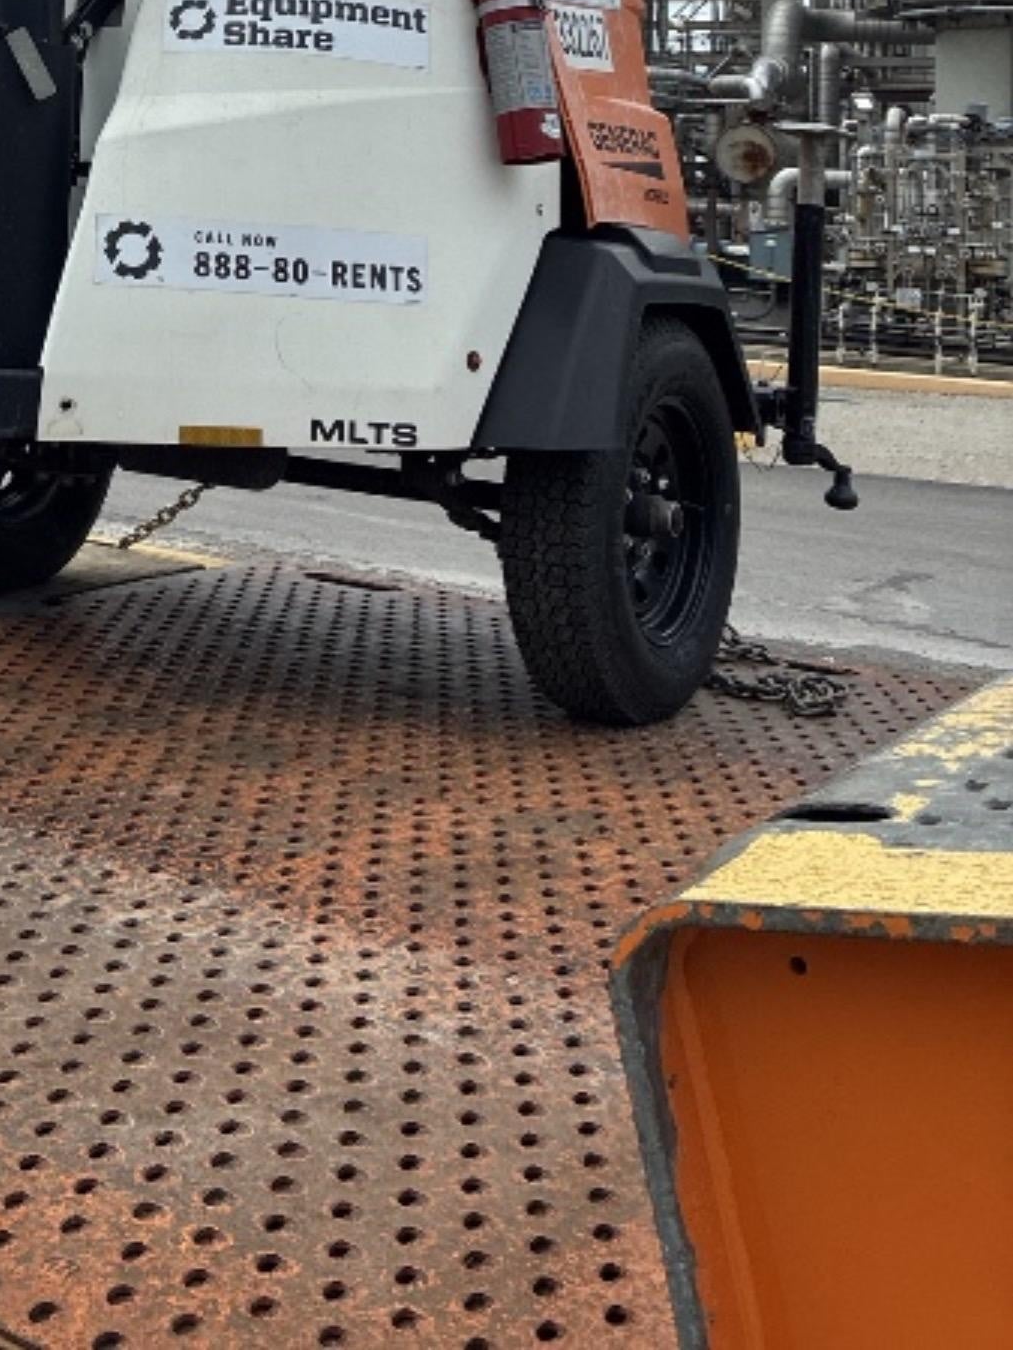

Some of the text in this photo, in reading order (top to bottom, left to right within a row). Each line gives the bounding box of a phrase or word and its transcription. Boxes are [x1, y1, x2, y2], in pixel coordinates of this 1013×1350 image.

[223, 21, 334, 52] Share
[193, 230, 278, 249] CALL NOW
[193, 251, 423, 294] 888-80-RENTS
[310, 419, 418, 448] MLTS
